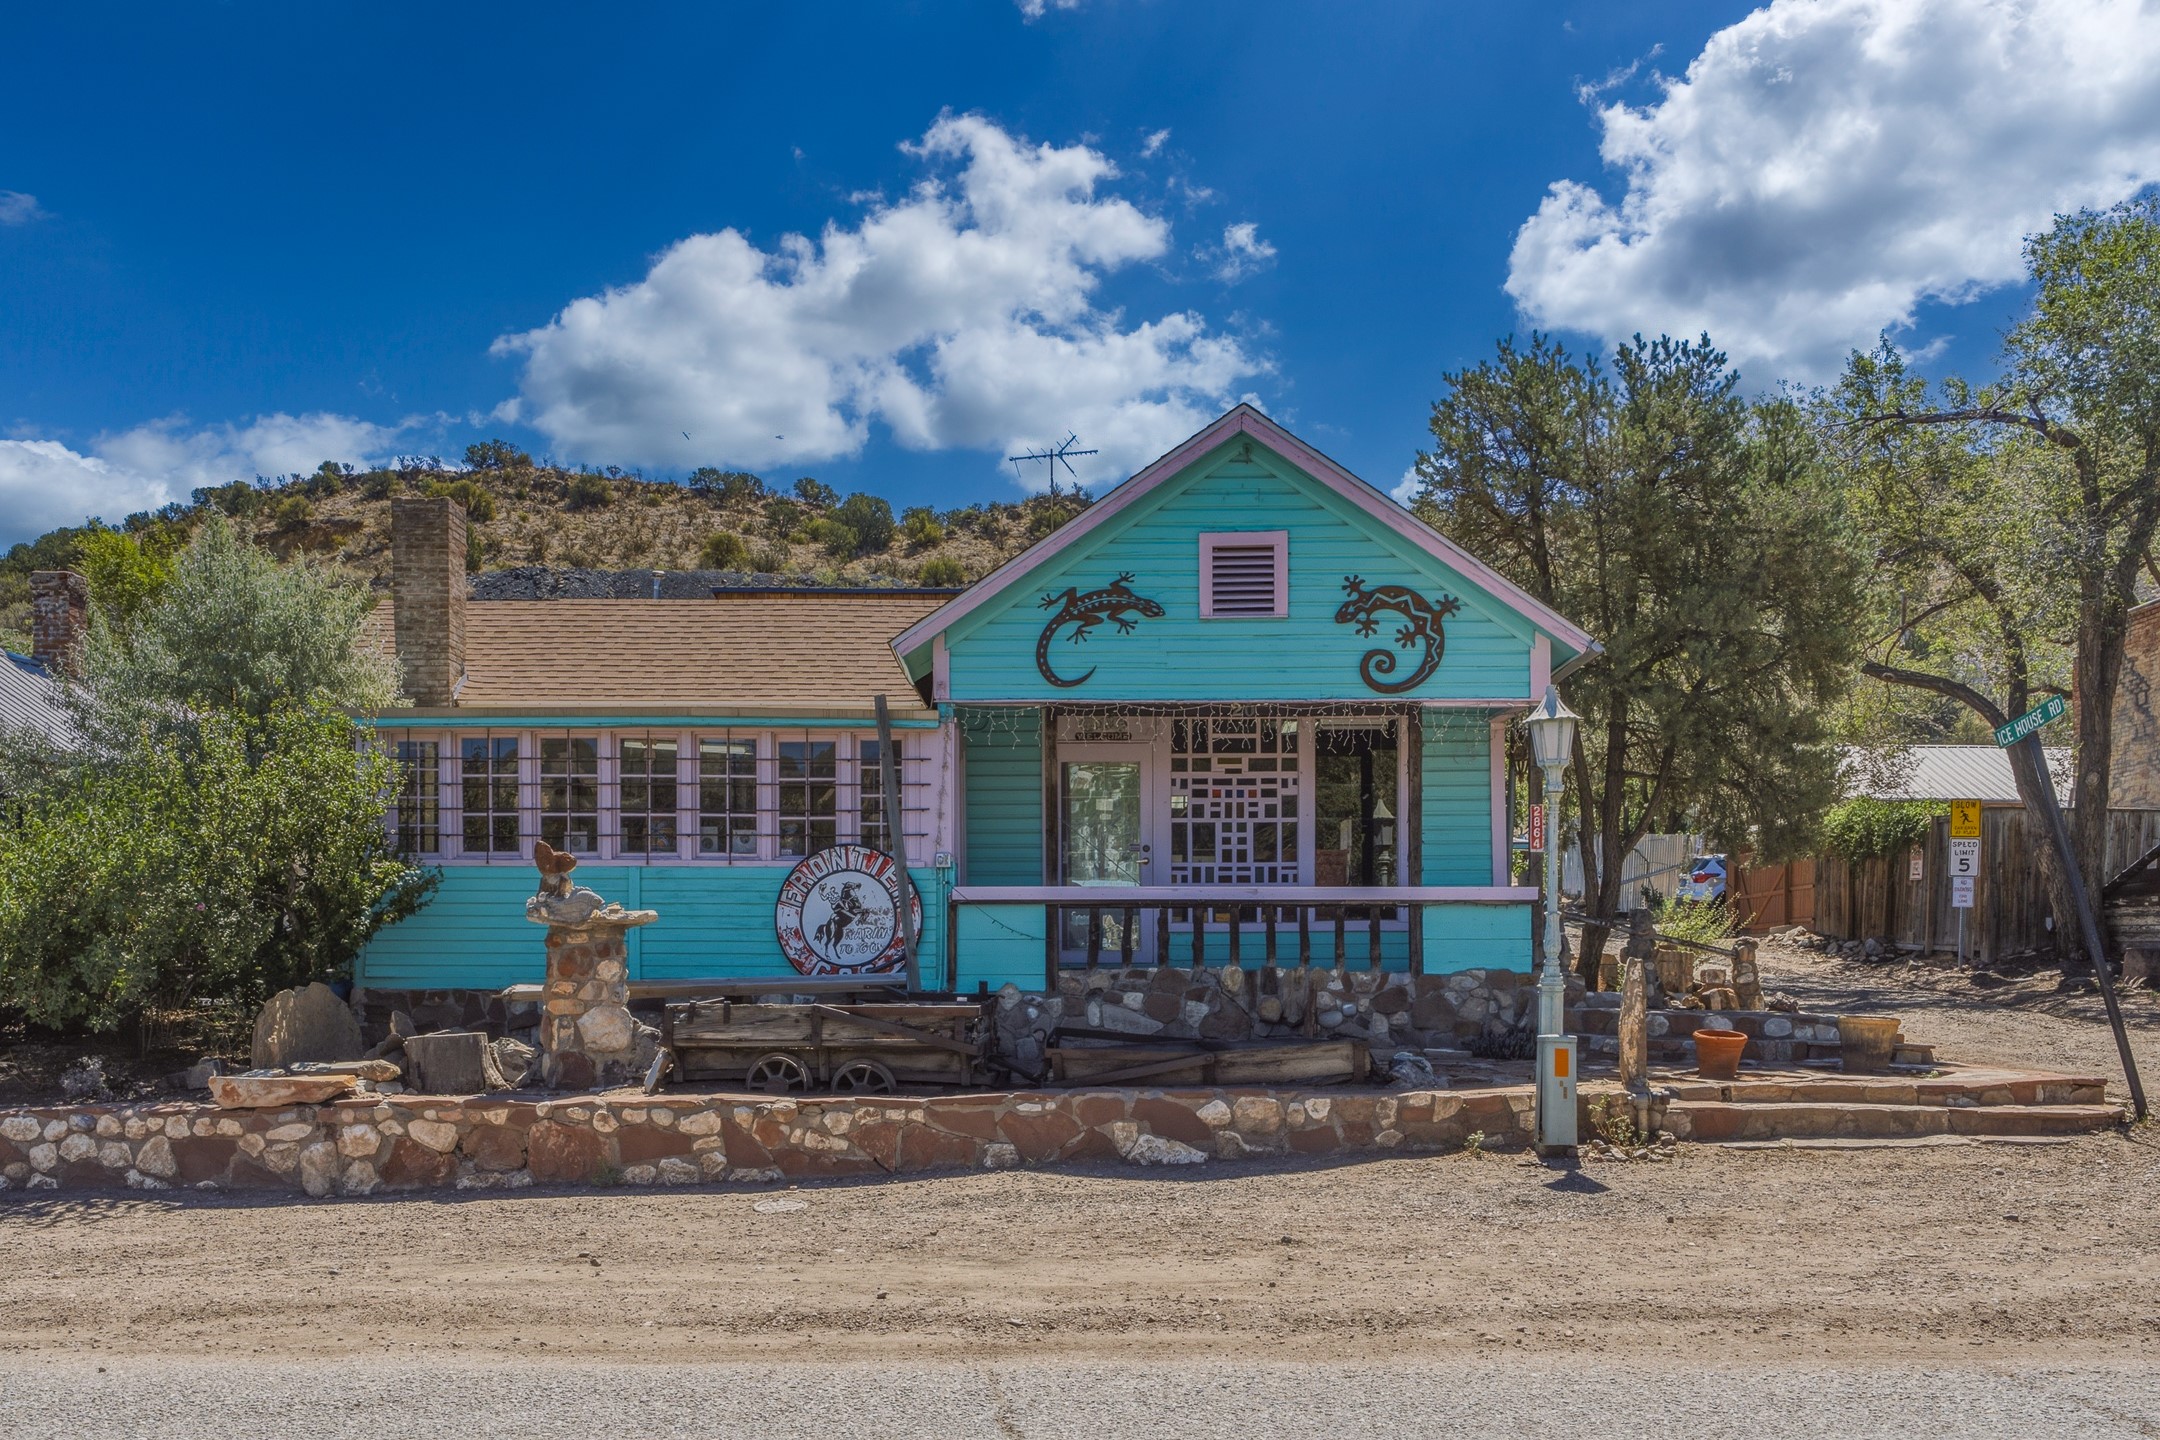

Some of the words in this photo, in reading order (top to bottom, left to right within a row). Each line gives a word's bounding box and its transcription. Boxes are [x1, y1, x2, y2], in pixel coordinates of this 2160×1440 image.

[1996, 727, 2014, 747] ICE
[2014, 708, 2045, 737] HOUSE
[2047, 698, 2062, 717] RD
[1955, 800, 1977, 809] SLOW
[1533, 806, 1541, 849] 2864
[1958, 858, 1970, 872] 5
[840, 944, 853, 954] TO
